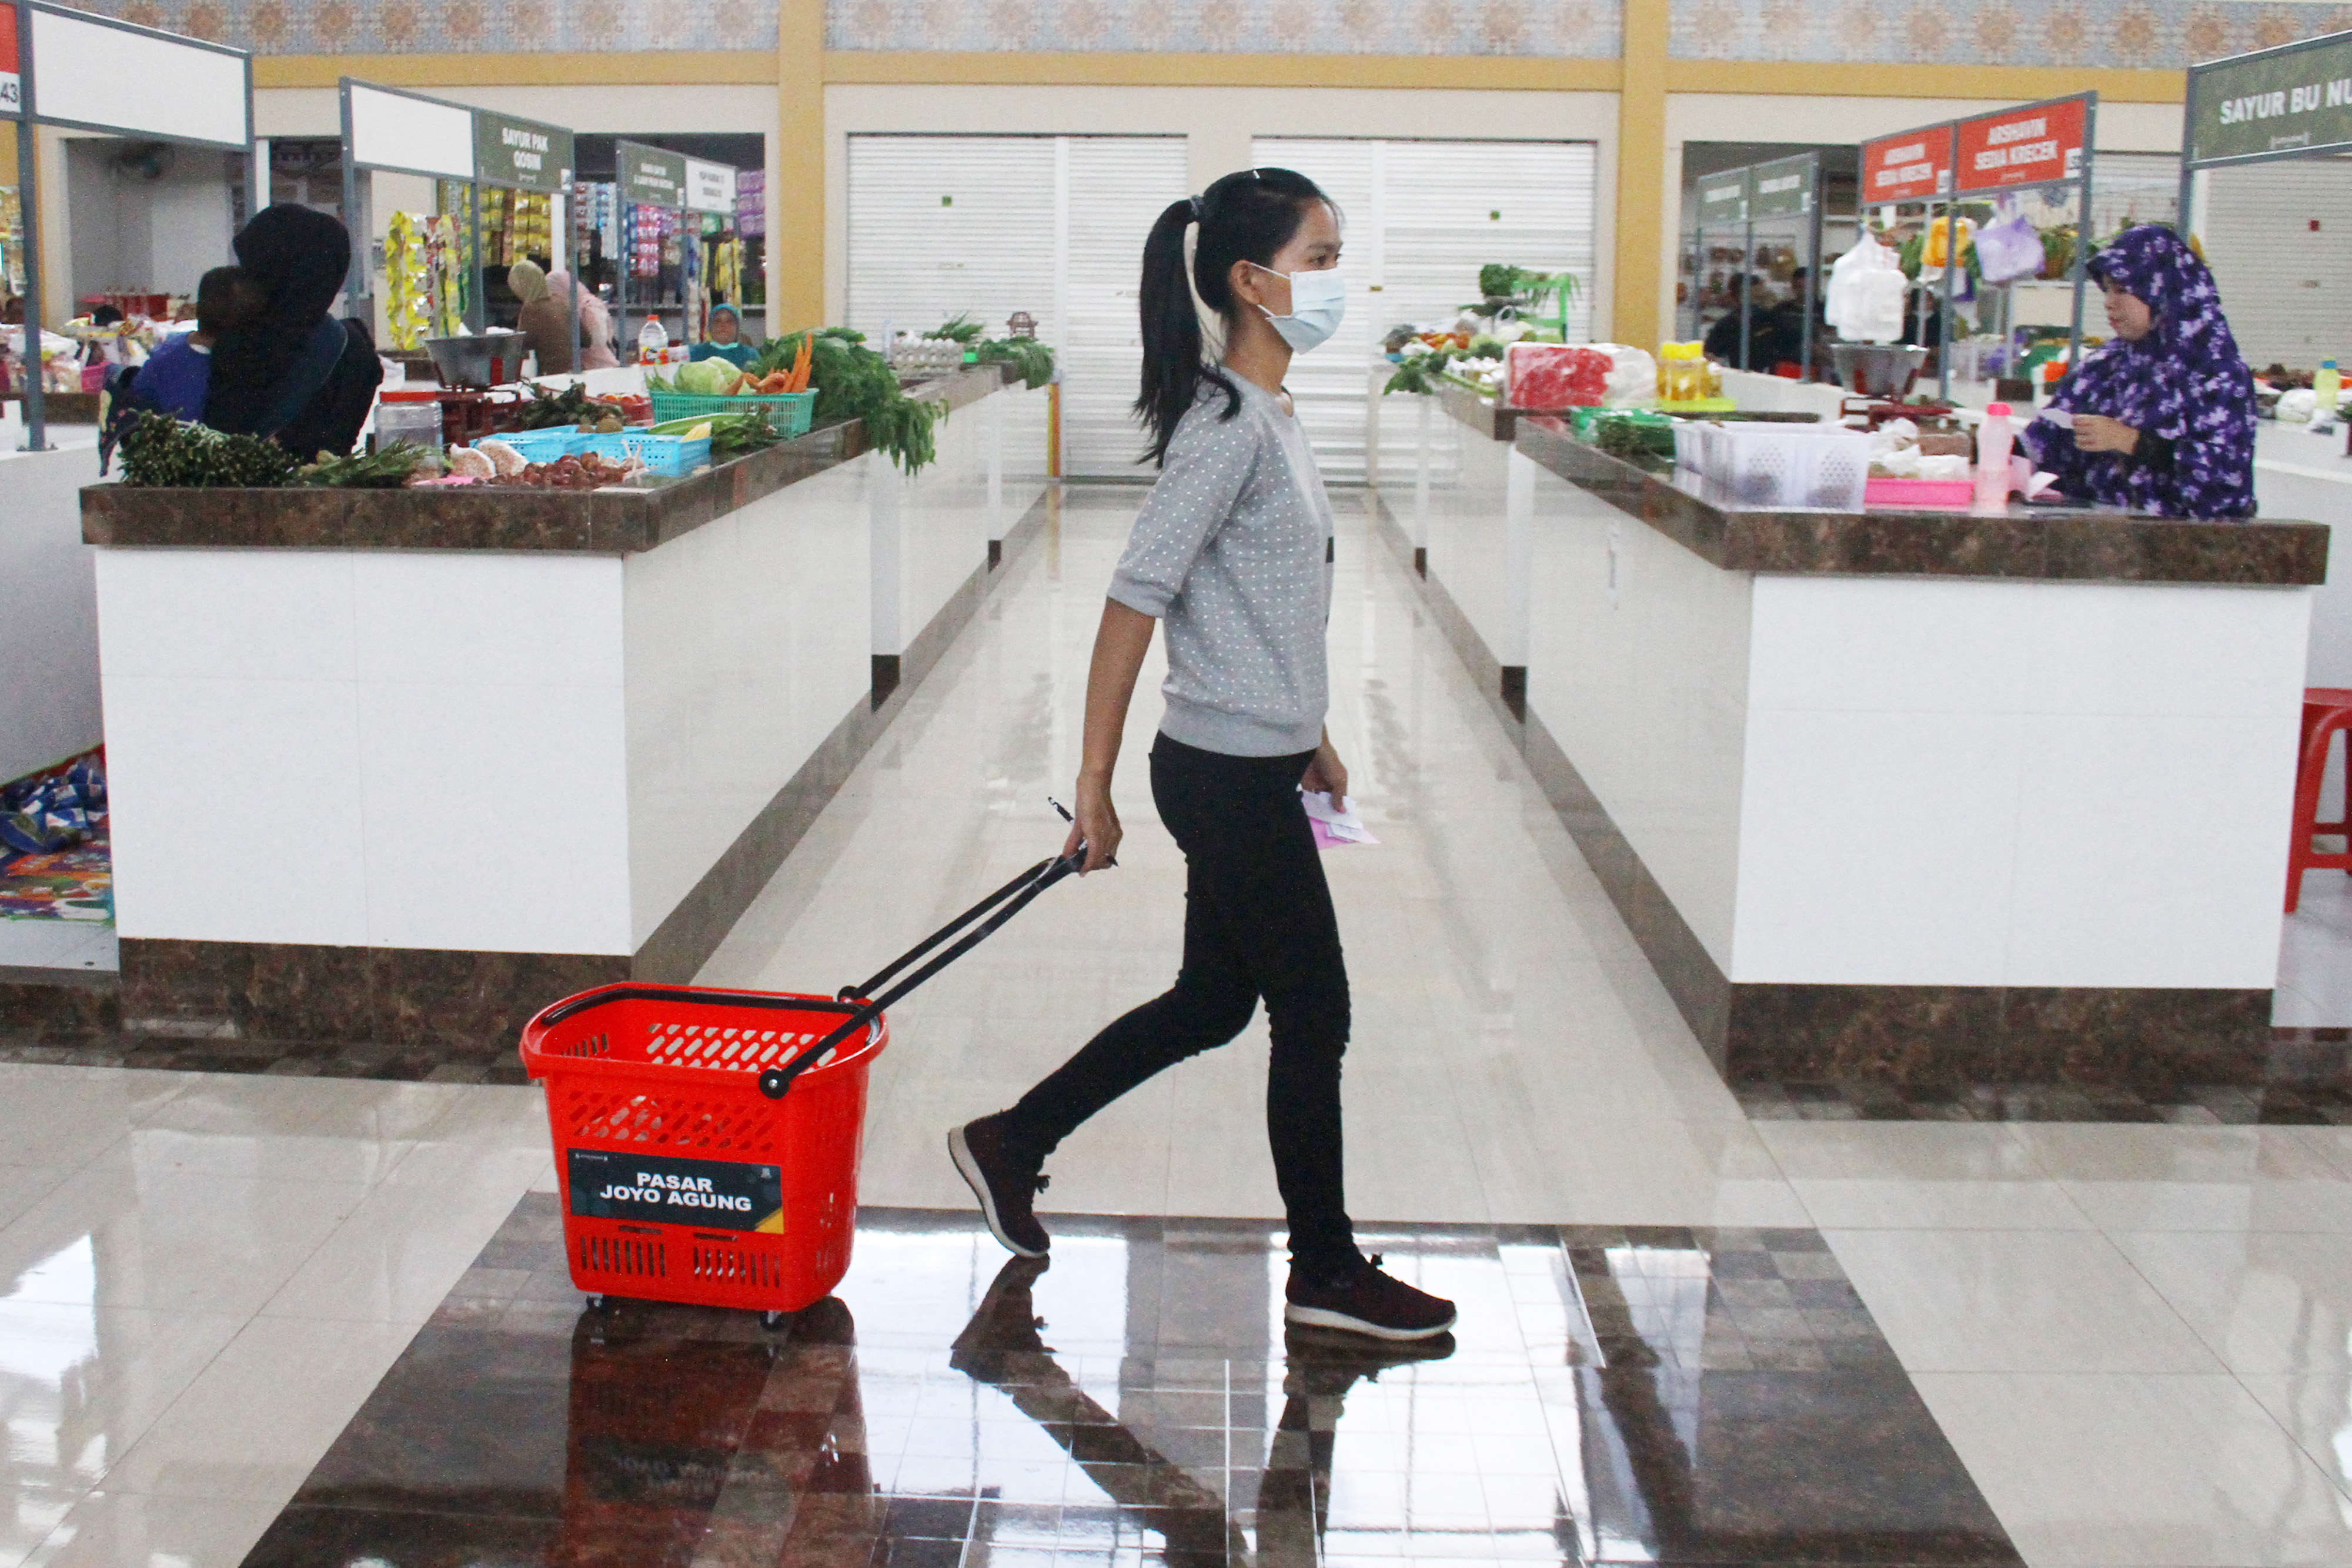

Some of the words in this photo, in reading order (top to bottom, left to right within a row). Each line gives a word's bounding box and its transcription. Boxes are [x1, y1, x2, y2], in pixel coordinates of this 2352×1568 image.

[2220, 90, 2286, 125] SAYUR
[2290, 83, 2321, 113] BU
[502, 126, 531, 149] SAYUR
[532, 133, 549, 152] PAK
[1974, 148, 2007, 170] SEDIA
[2009, 139, 2058, 165] KRECEK
[637, 1172, 713, 1192] PASAR
[599, 1184, 661, 1202] JOYO
[667, 1190, 753, 1212] AGUNG
